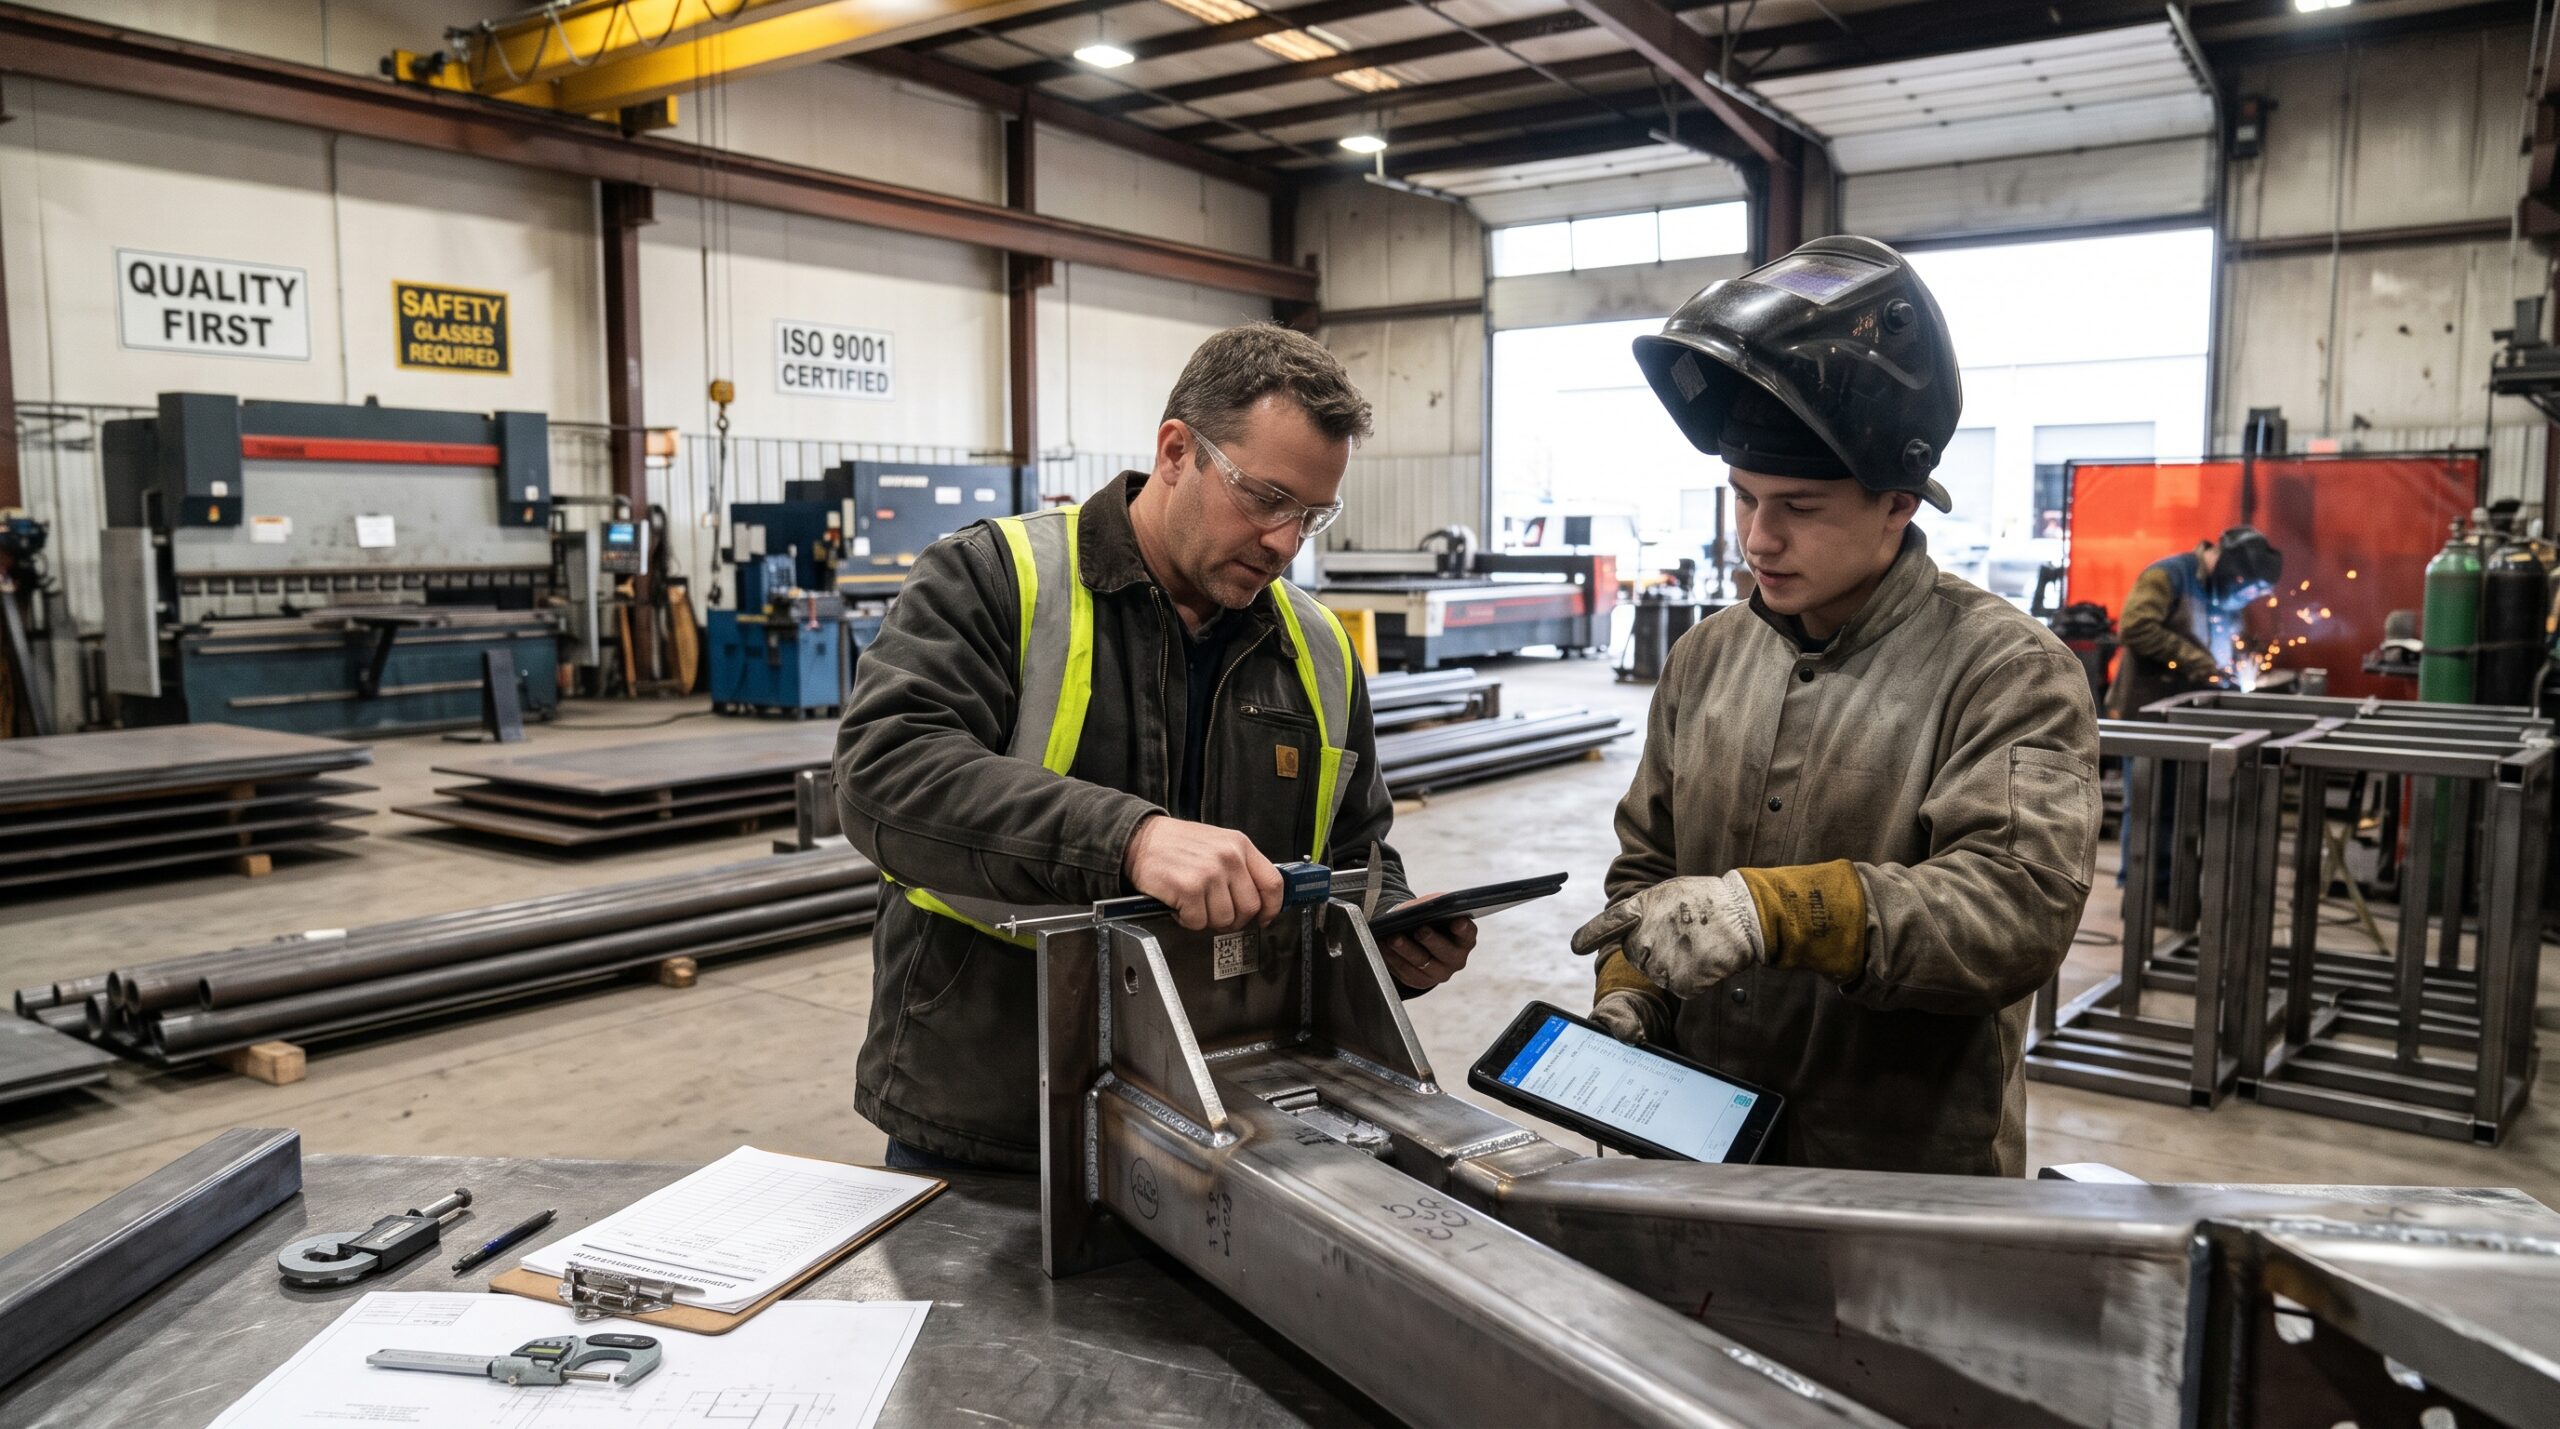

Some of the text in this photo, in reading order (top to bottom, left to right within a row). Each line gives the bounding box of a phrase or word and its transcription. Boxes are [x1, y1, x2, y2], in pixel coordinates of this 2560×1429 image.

[129, 262, 296, 307] QUALITY
[402, 289, 501, 323] SAFETY
[163, 309, 272, 347] FIRST
[413, 320, 495, 345] GLASSES
[783, 327, 886, 363] ISO 9001
[408, 342, 500, 367] REQUIRED
[783, 363, 888, 392] CERTIFIED
